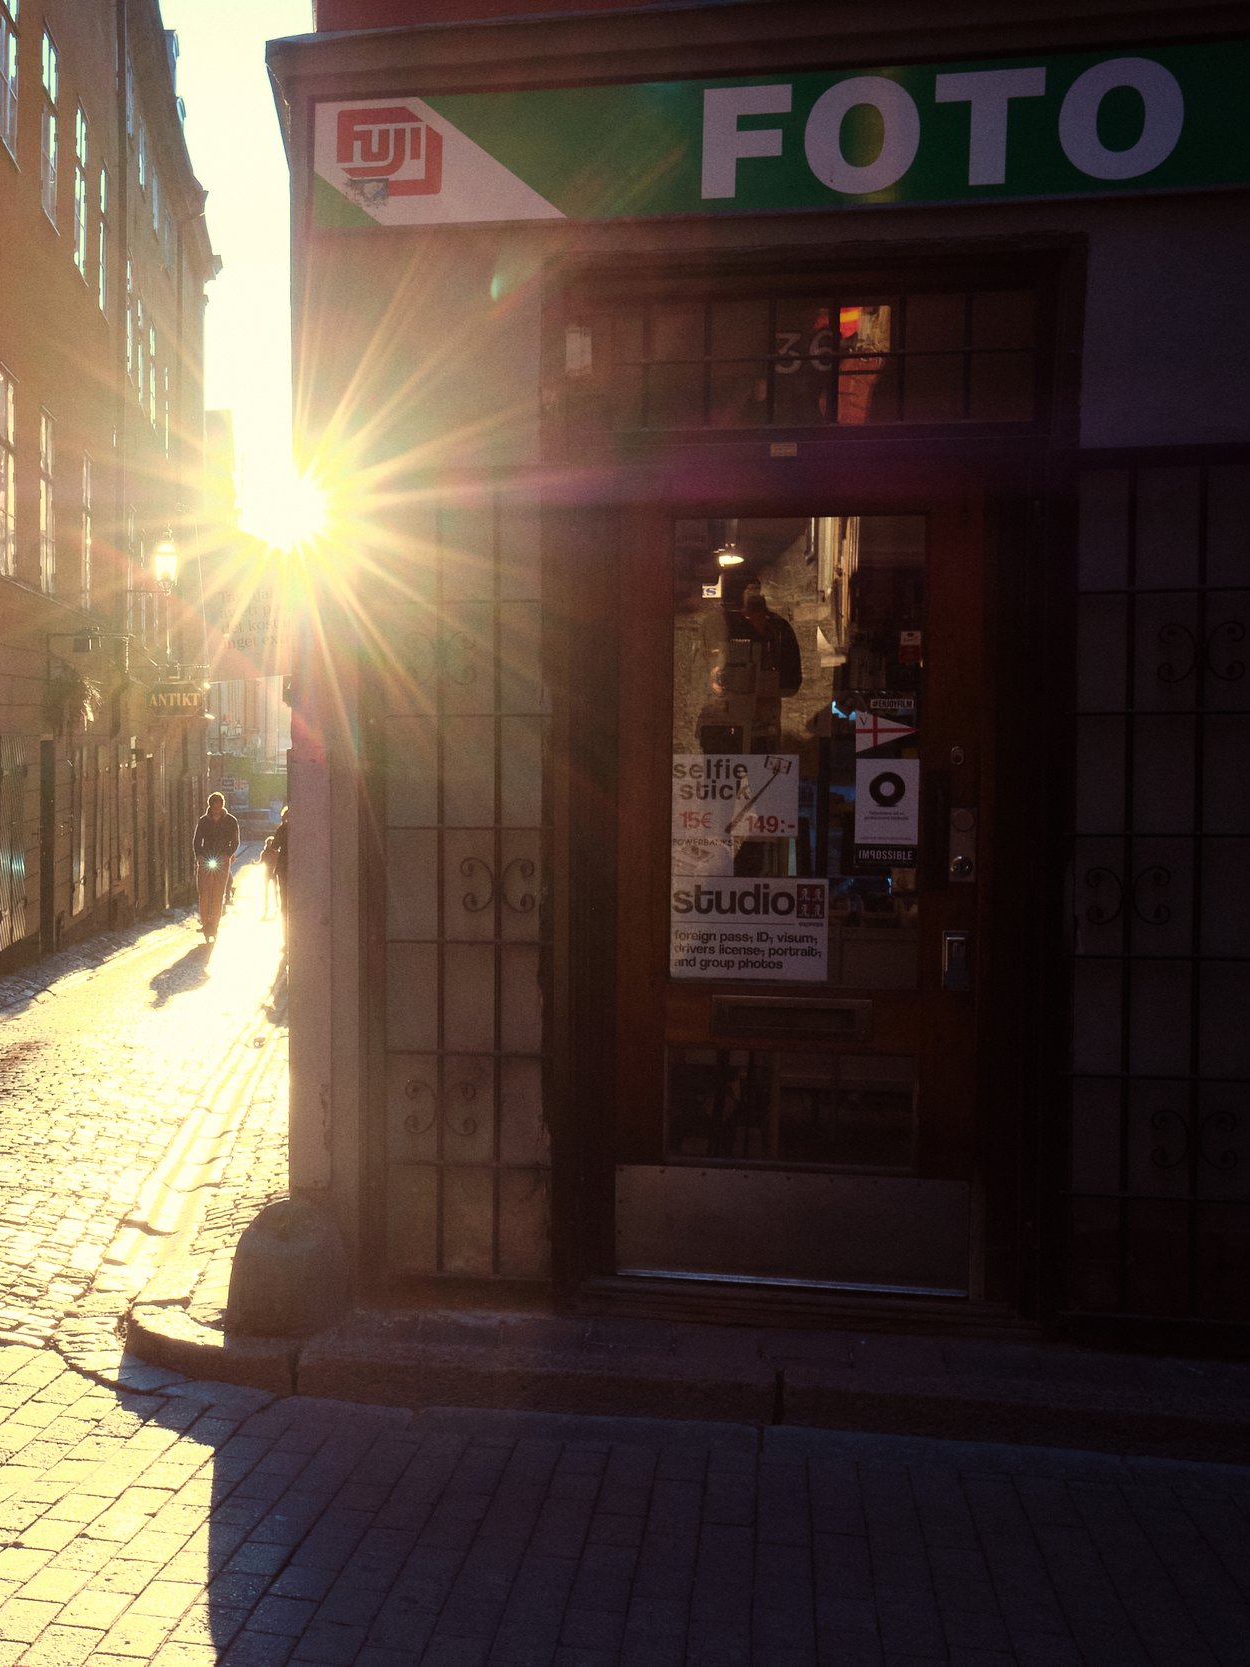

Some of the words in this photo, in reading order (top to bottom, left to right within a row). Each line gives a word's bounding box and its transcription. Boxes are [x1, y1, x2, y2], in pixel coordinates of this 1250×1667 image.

[701, 56, 1185, 200] FOTO
[337, 112, 434, 188] FUJI
[149, 693, 201, 707] ANTIKT
[673, 758, 749, 781] selfie
[679, 780, 751, 802] stick
[680, 811, 713, 829] 15€
[744, 815, 796, 834] 149:-
[672, 884, 796, 916] studio
[674, 929, 718, 944] foreign
[674, 942, 716, 955] drivers
[674, 956, 697, 967] and
[699, 958, 735, 970] group
[737, 956, 784, 969] photos
